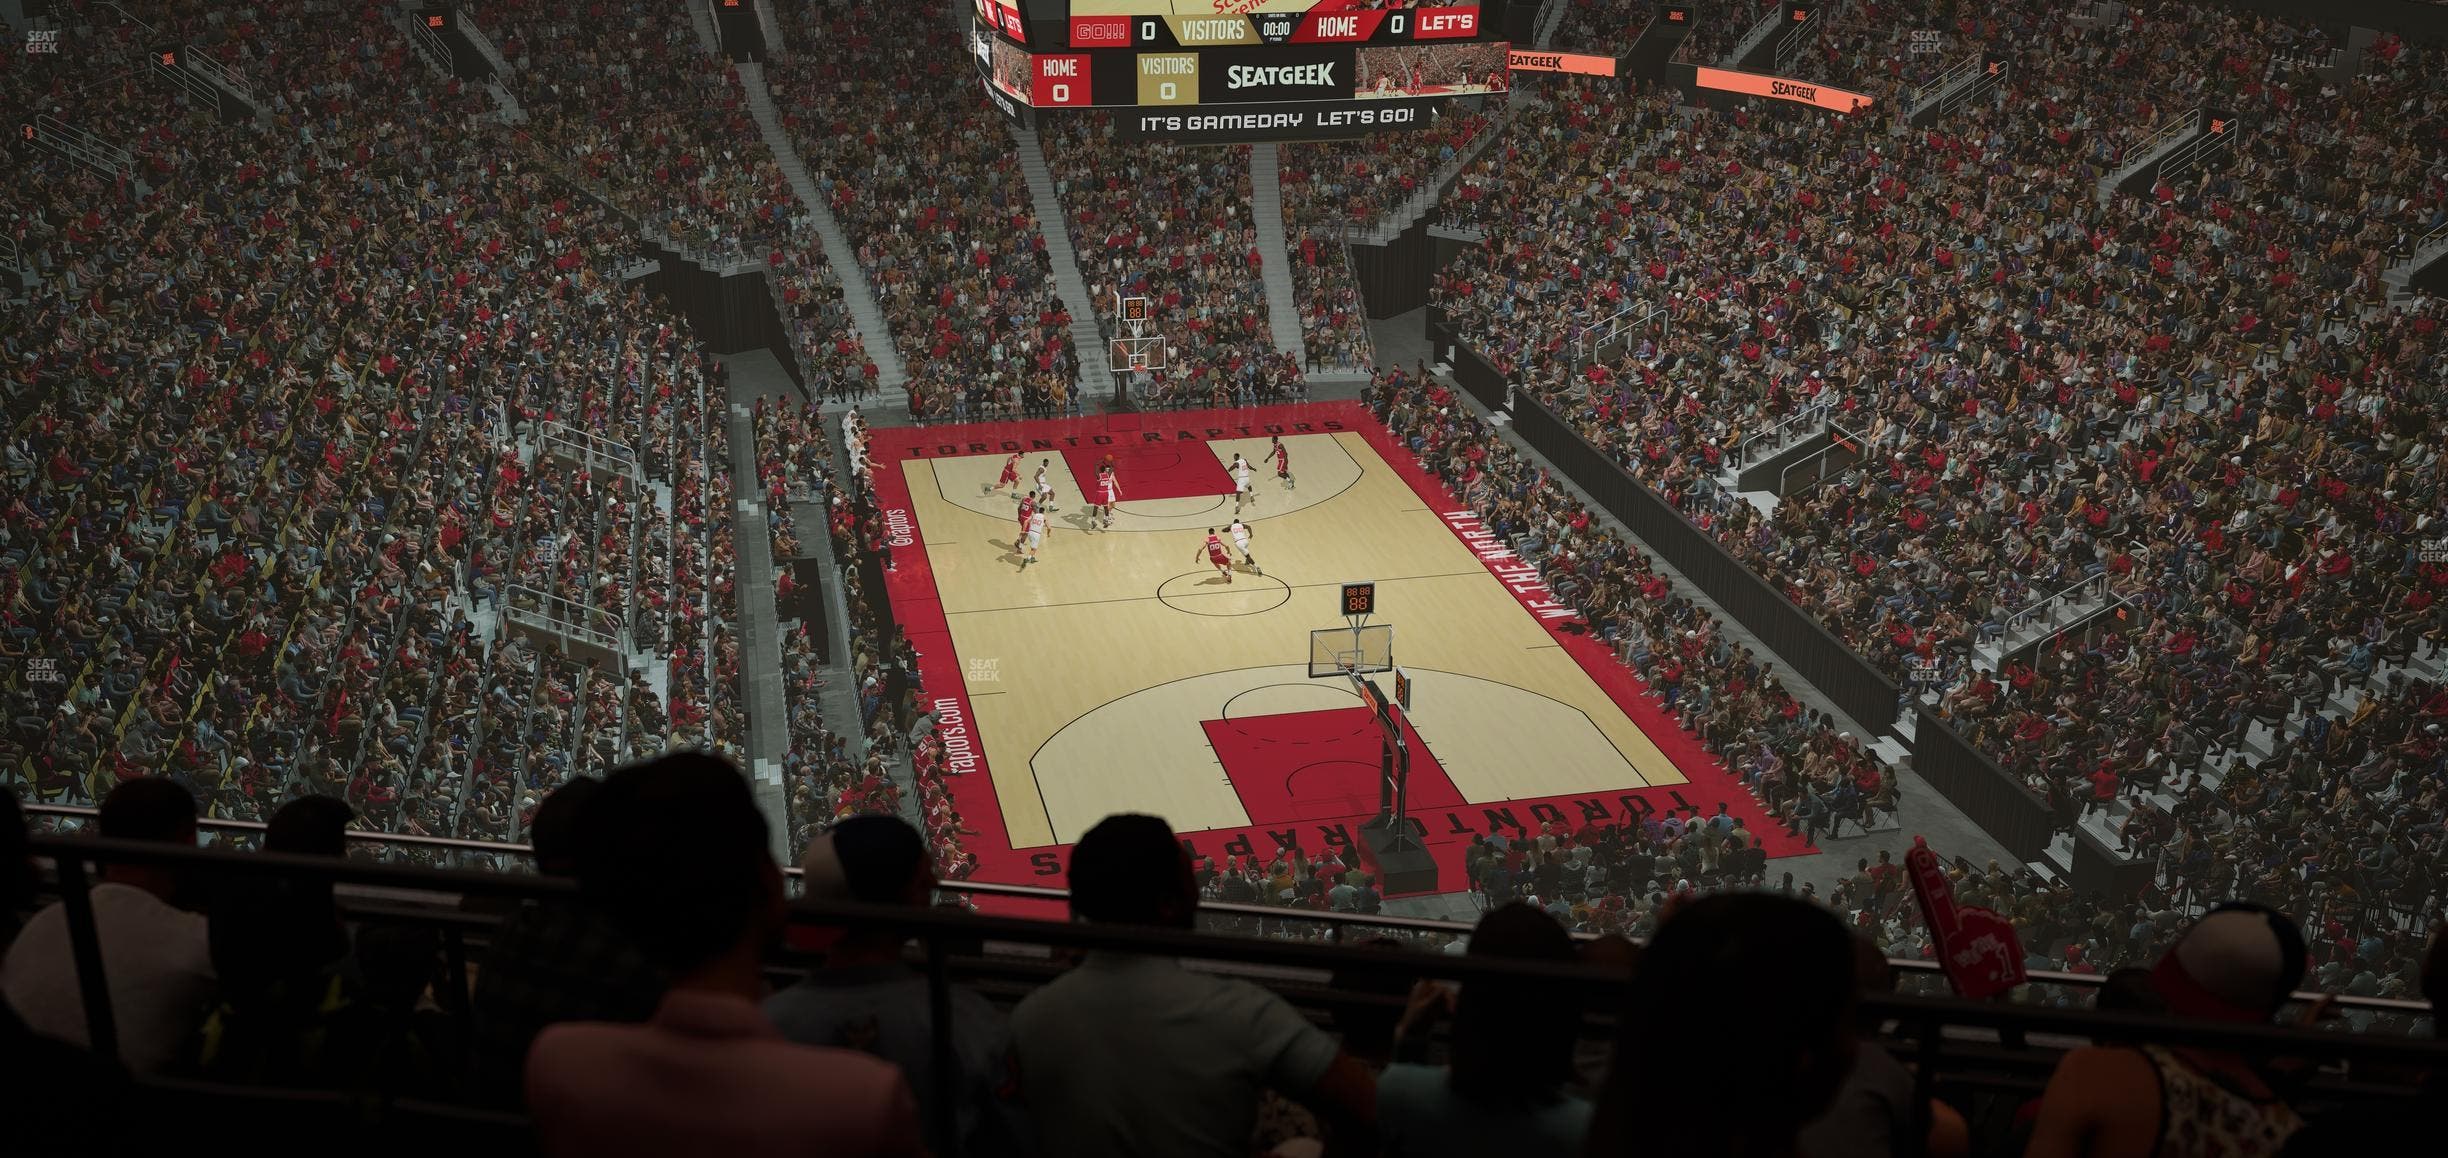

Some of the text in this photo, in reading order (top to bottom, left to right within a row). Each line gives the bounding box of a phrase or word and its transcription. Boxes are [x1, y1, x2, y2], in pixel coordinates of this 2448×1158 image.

[1076, 23, 1125, 40] GO!!!
[1141, 21, 1156, 40] 0
[1182, 19, 1245, 40] VISITORS
[1263, 21, 1290, 36] 00:00
[1317, 16, 1358, 37] HOME
[1391, 15, 1404, 33] 0
[1421, 14, 1473, 31] LET'S
[1043, 59, 1077, 77] HOME
[1142, 57, 1194, 75] VISITORS
[1510, 54, 1562, 69] EATGEEK
[1227, 61, 1335, 89] SEATGEEK
[1053, 84, 1069, 102] 0
[1160, 82, 1176, 100] 0
[1771, 81, 1817, 102] SEATGEEK
[1141, 108, 1414, 131] IT'S GAMEDAY LET'S GO!
[907, 421, 1345, 457] TORONTO RAPTORS
[886, 509, 915, 546] @raptors
[1443, 510, 1519, 560] NORTH
[1494, 562, 1550, 594] THE
[934, 698, 980, 773] raptors.com
